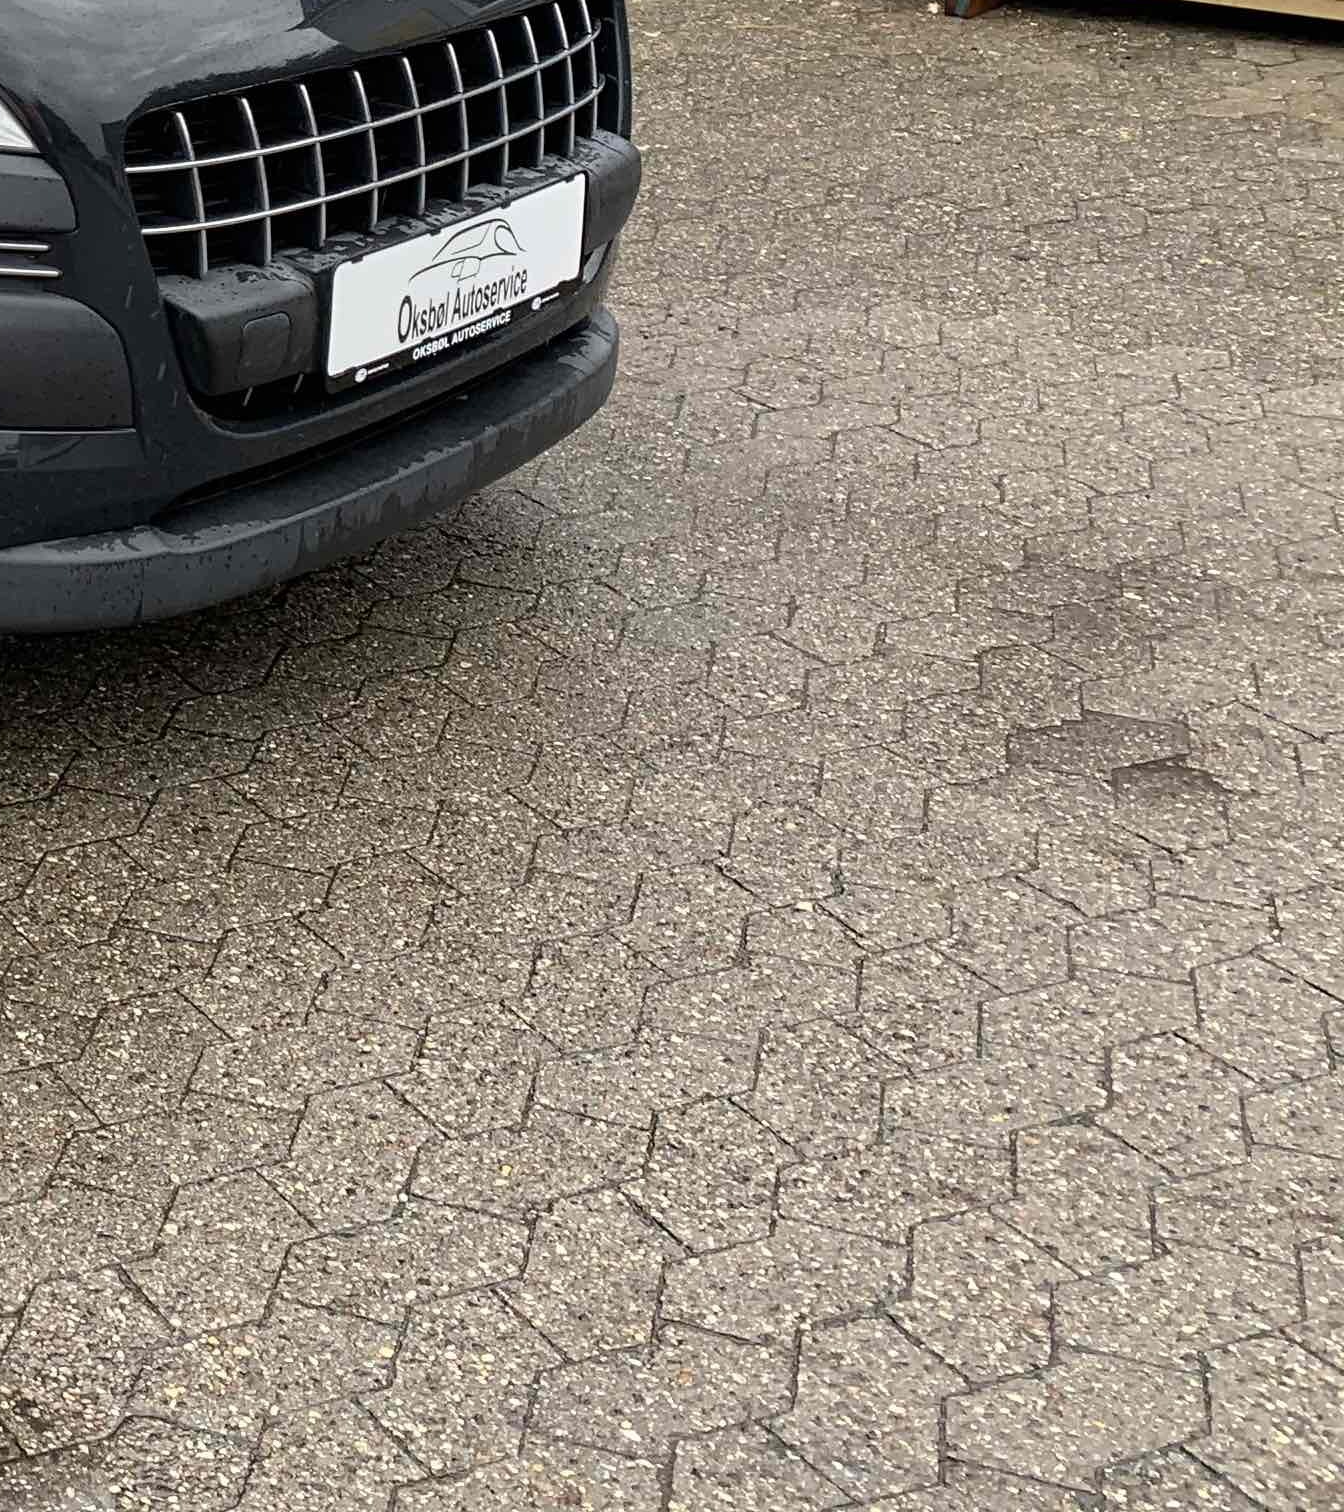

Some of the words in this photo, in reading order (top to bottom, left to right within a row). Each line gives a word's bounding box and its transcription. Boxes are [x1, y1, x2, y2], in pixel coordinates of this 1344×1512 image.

[397, 291, 451, 344] Oksbøl
[451, 264, 529, 322] Autoservice
[413, 338, 450, 361] OKSBØL
[450, 309, 512, 346] AUTOSERVICE
